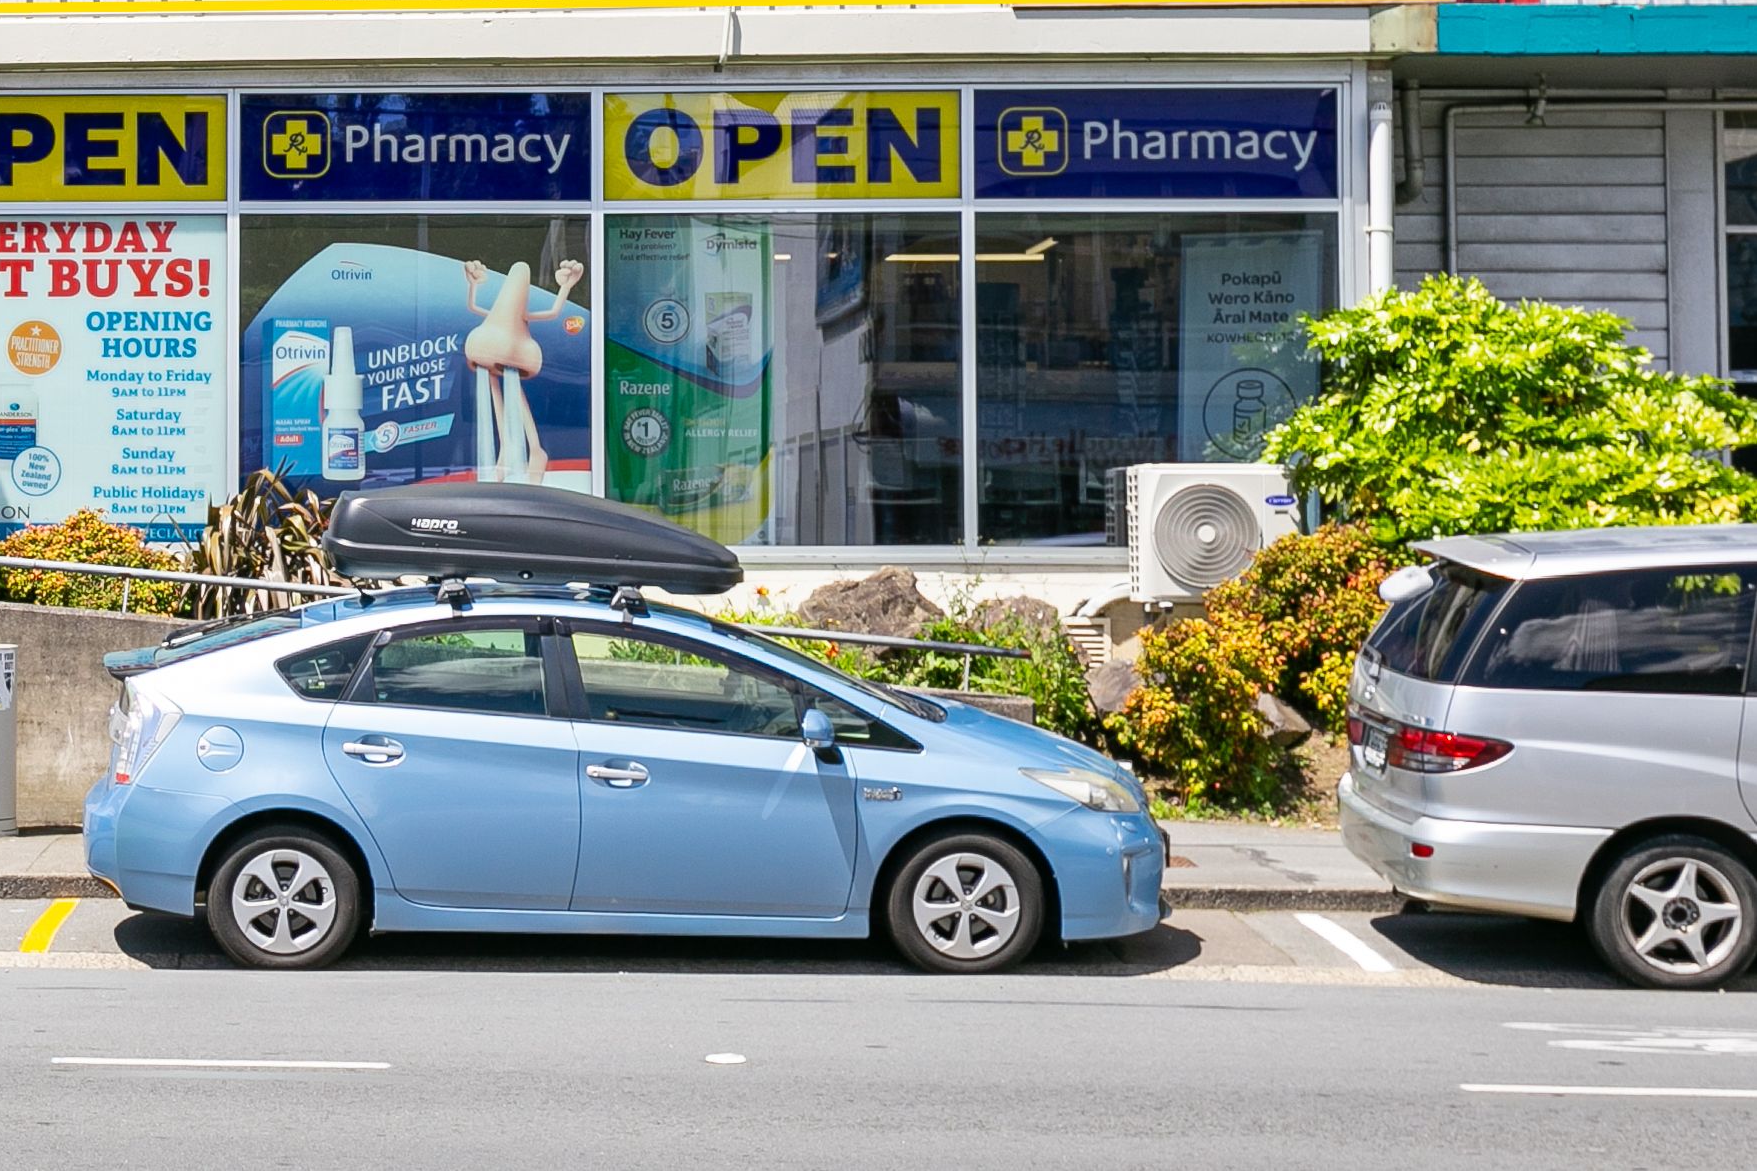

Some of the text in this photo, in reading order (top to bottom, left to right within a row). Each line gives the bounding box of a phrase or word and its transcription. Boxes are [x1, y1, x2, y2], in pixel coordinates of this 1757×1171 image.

[345, 124, 571, 174] Pharmacy
[624, 108, 941, 186] OPEN
[1084, 119, 1317, 172] Pharmacy
[620, 229, 676, 241] Hay Fever
[641, 243, 676, 251] problem?
[706, 239, 757, 253] Dymista
[48, 259, 210, 298] BUYS!
[331, 269, 372, 280] Otrivin
[1222, 271, 1281, 288] Pokapū
[1208, 290, 1295, 305] Wero Kāno
[86, 311, 212, 332] OPENING
[661, 313, 674, 329] 5
[1249, 311, 1289, 323] Mate
[11, 336, 59, 354] PRACTITIONER
[101, 338, 197, 358] HOURS
[276, 345, 325, 359] Otrivin
[368, 333, 459, 369] UNBLOCK
[15, 352, 51, 369] STRENGTH
[87, 369, 212, 384] Monday to Friday
[367, 358, 446, 386] YOUR NOSE
[112, 387, 186, 397] 9AM to 11PM
[382, 374, 445, 411] FAST
[620, 380, 670, 395] Razene
[116, 408, 182, 423] Saturday
[112, 426, 186, 436] 8AM to 11PM
[403, 421, 437, 433] FASTER
[728, 429, 759, 437] RELIEF
[279, 435, 299, 443] Adult
[28, 453, 49, 463] 100%
[122, 447, 176, 462] Sunday
[28, 462, 46, 471] New
[112, 464, 186, 474] 8AM to 11PM
[21, 470, 51, 481] Zealand
[22, 480, 48, 490] owned
[673, 478, 710, 492] Razene
[93, 486, 205, 501] Public Holidays
[112, 503, 186, 513] 8AM to 11PM
